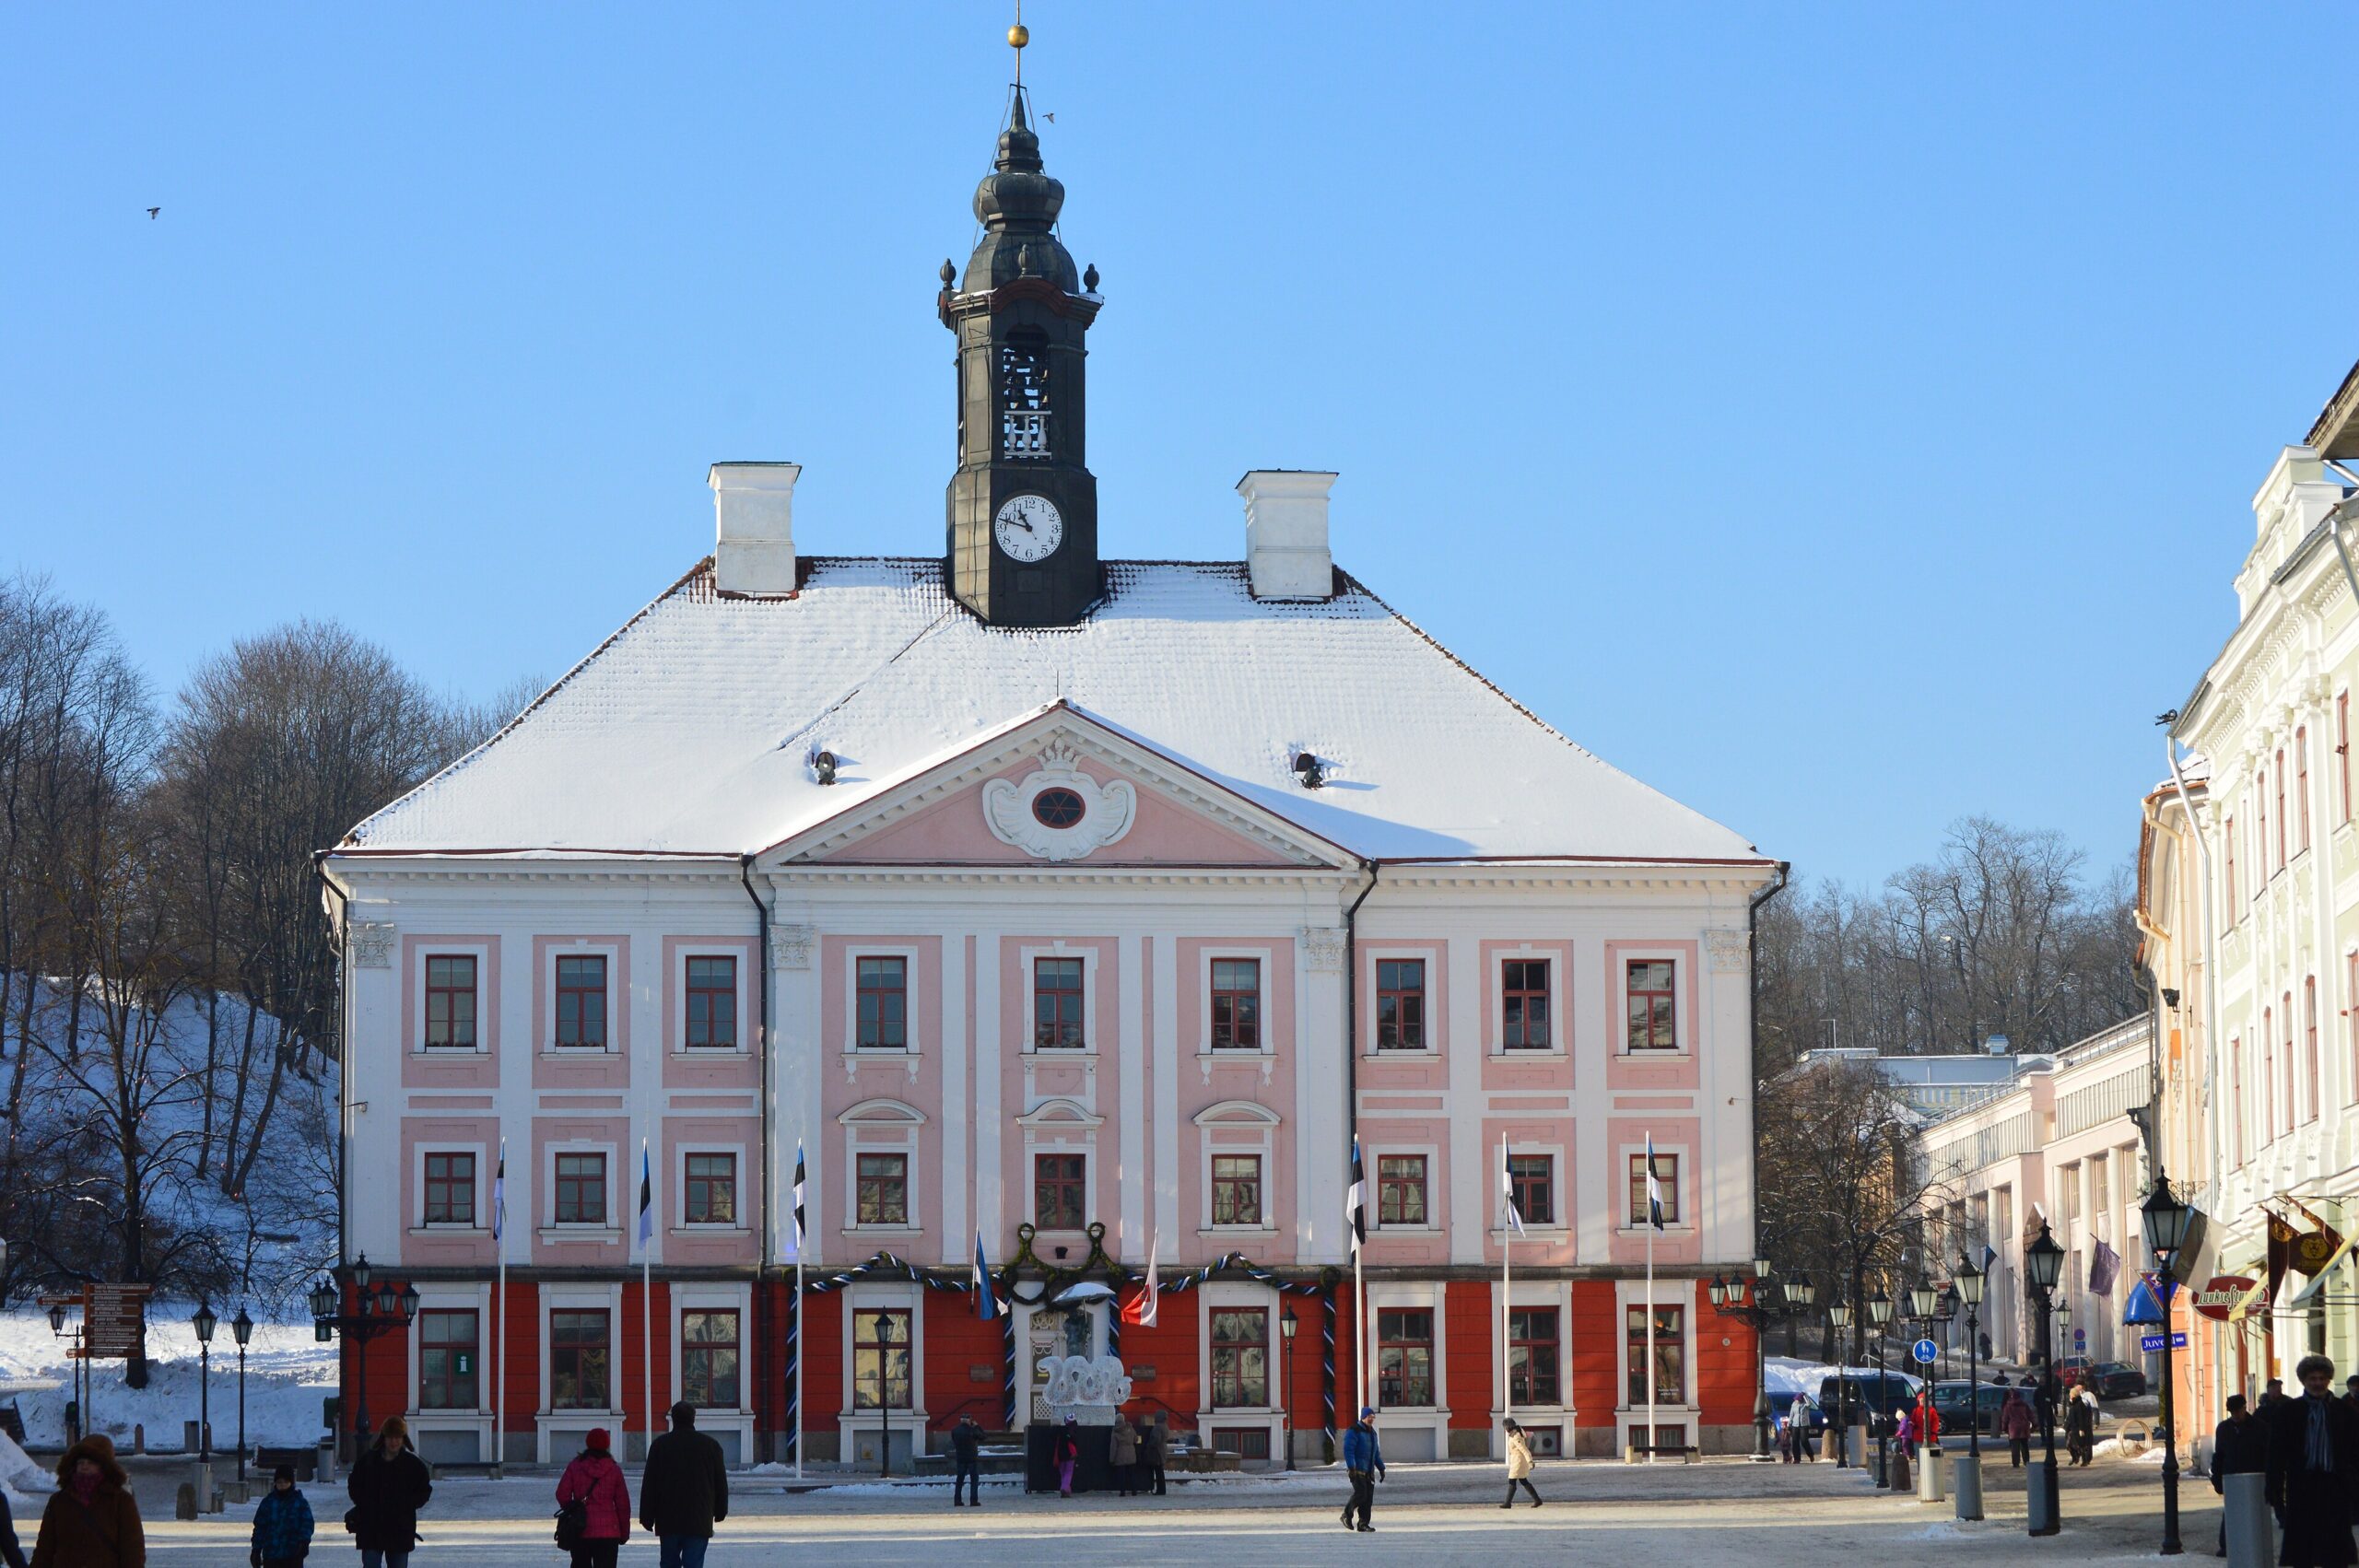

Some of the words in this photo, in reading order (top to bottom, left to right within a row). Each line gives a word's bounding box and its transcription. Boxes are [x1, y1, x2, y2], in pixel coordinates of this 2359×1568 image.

[1013, 503, 1022, 512] 11
[1024, 500, 1036, 509] 12
[1040, 504, 1046, 513] 1
[1005, 512, 1016, 521] 10
[1049, 513, 1055, 521] 2
[1000, 523, 1007, 532] 9
[1051, 524, 1059, 533] 3
[1003, 535, 1011, 544] 8
[1048, 535, 1055, 544] 4
[1012, 544, 1019, 554] 7
[1025, 548, 1033, 558] 6
[1040, 544, 1049, 554] 5
[2143, 1336, 2176, 1348] Juvel
